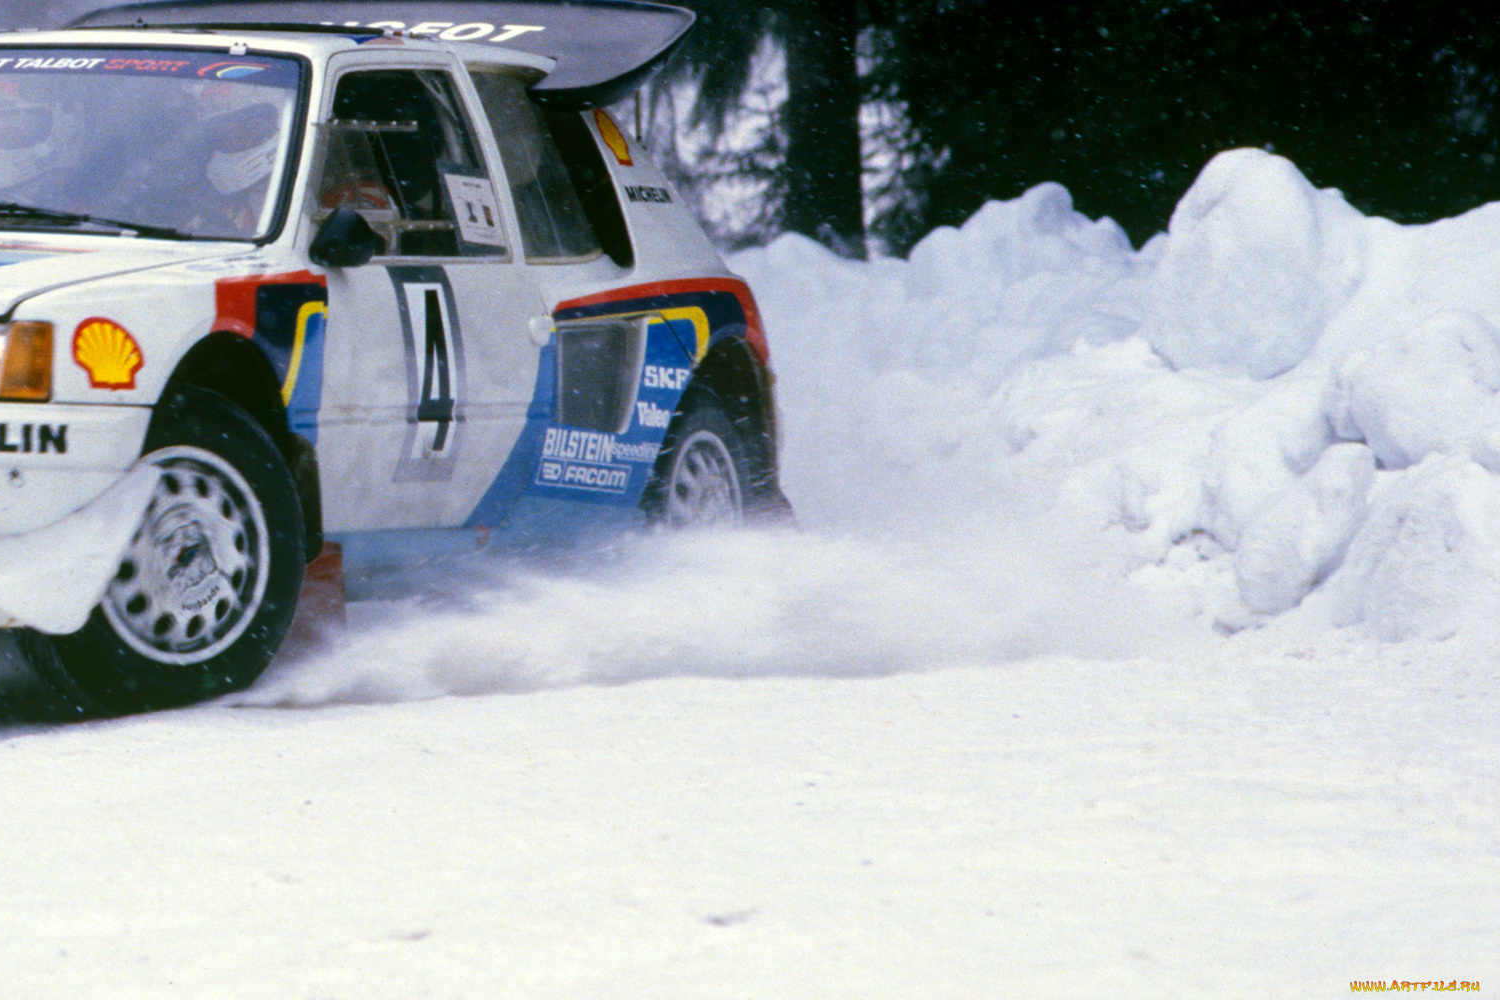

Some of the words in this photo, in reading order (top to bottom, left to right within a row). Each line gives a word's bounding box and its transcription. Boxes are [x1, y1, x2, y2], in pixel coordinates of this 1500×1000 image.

[13, 57, 106, 70] TALBOT
[104, 58, 190, 73] SPORT
[624, 185, 672, 203] MICHELIN
[417, 289, 455, 452] 4
[644, 365, 690, 389] SKF
[637, 401, 670, 428] Valeo
[542, 428, 615, 462] BILSTEIN
[565, 465, 626, 487] FACOM
